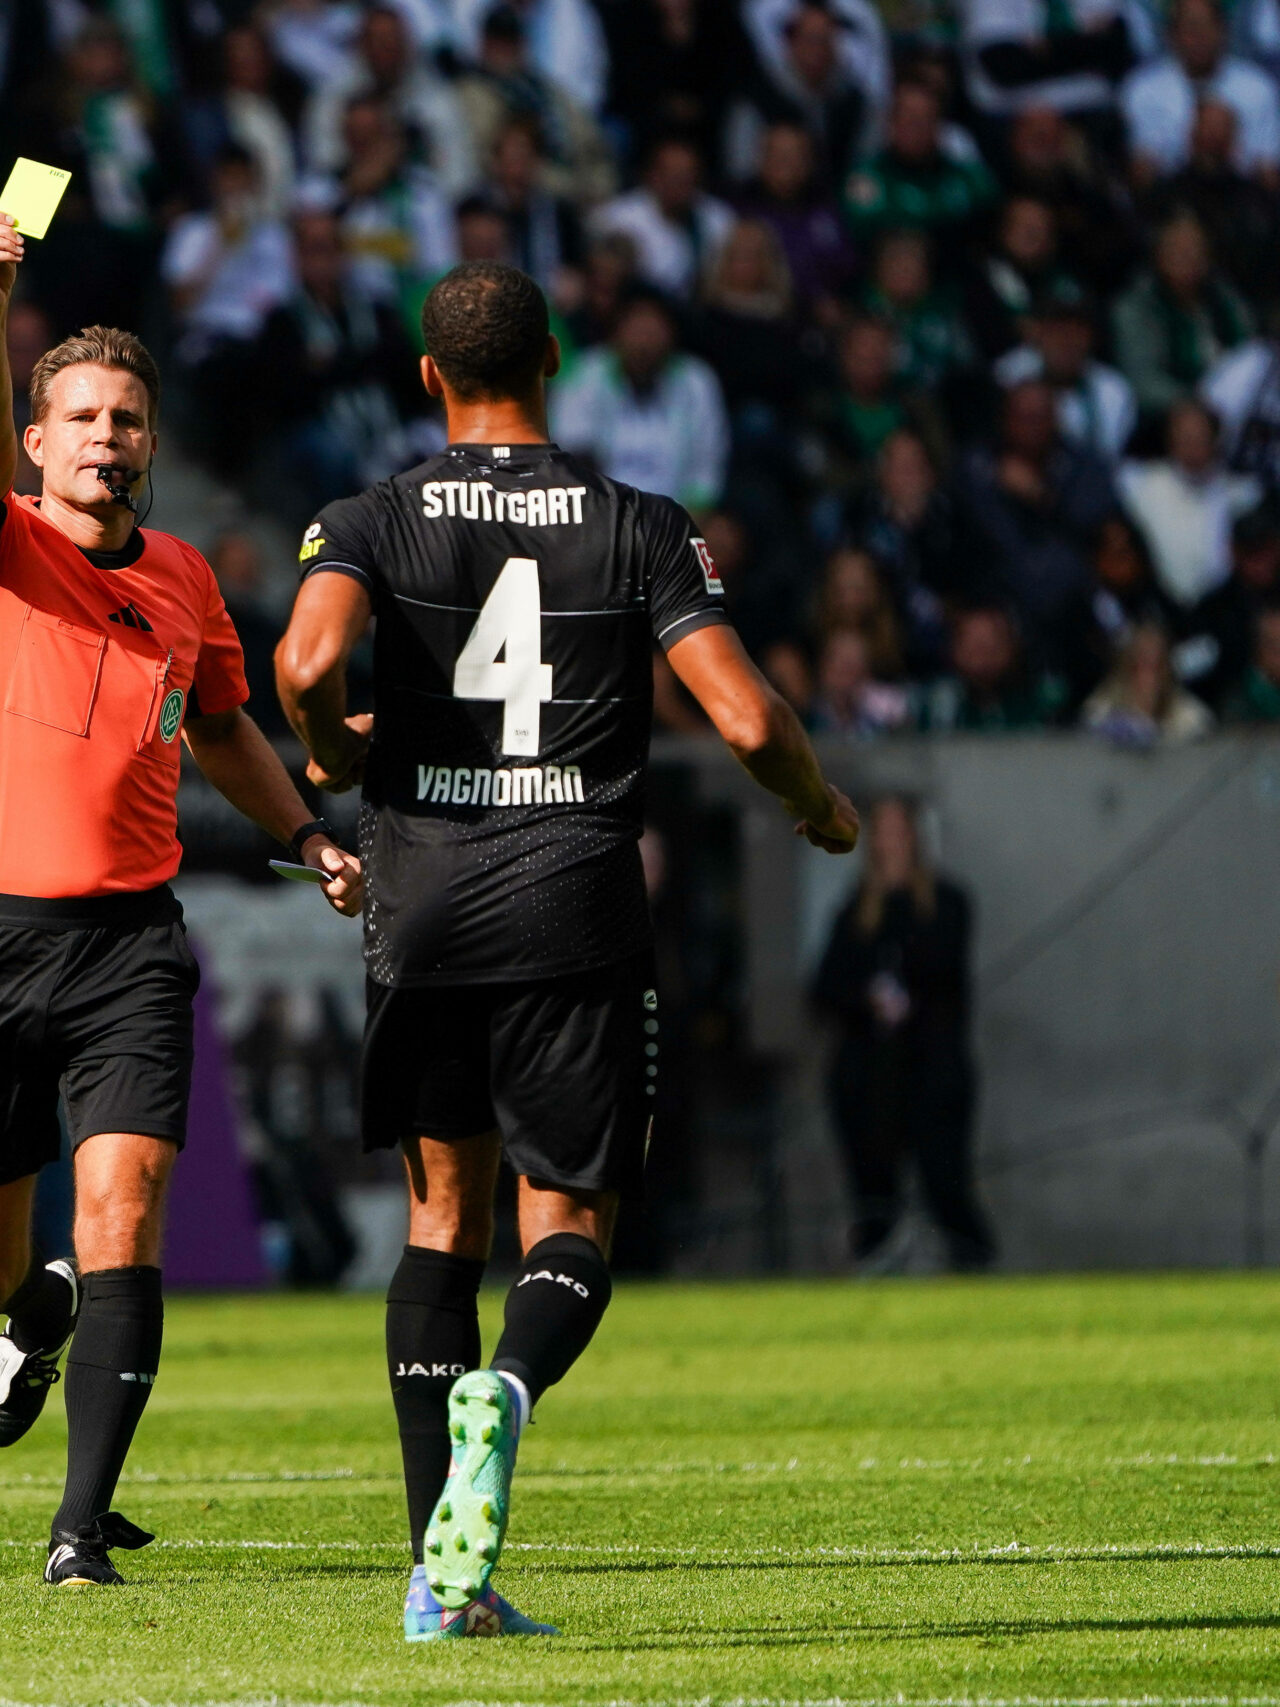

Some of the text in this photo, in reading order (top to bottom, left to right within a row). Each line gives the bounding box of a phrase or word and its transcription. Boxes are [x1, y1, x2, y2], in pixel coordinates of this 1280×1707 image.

[422, 481, 587, 527] STUTTGART
[452, 557, 553, 757] 4
[416, 764, 585, 807] VAGNOMAN
[517, 1270, 590, 1299] JAKO
[396, 1362, 466, 1377] JAKO
